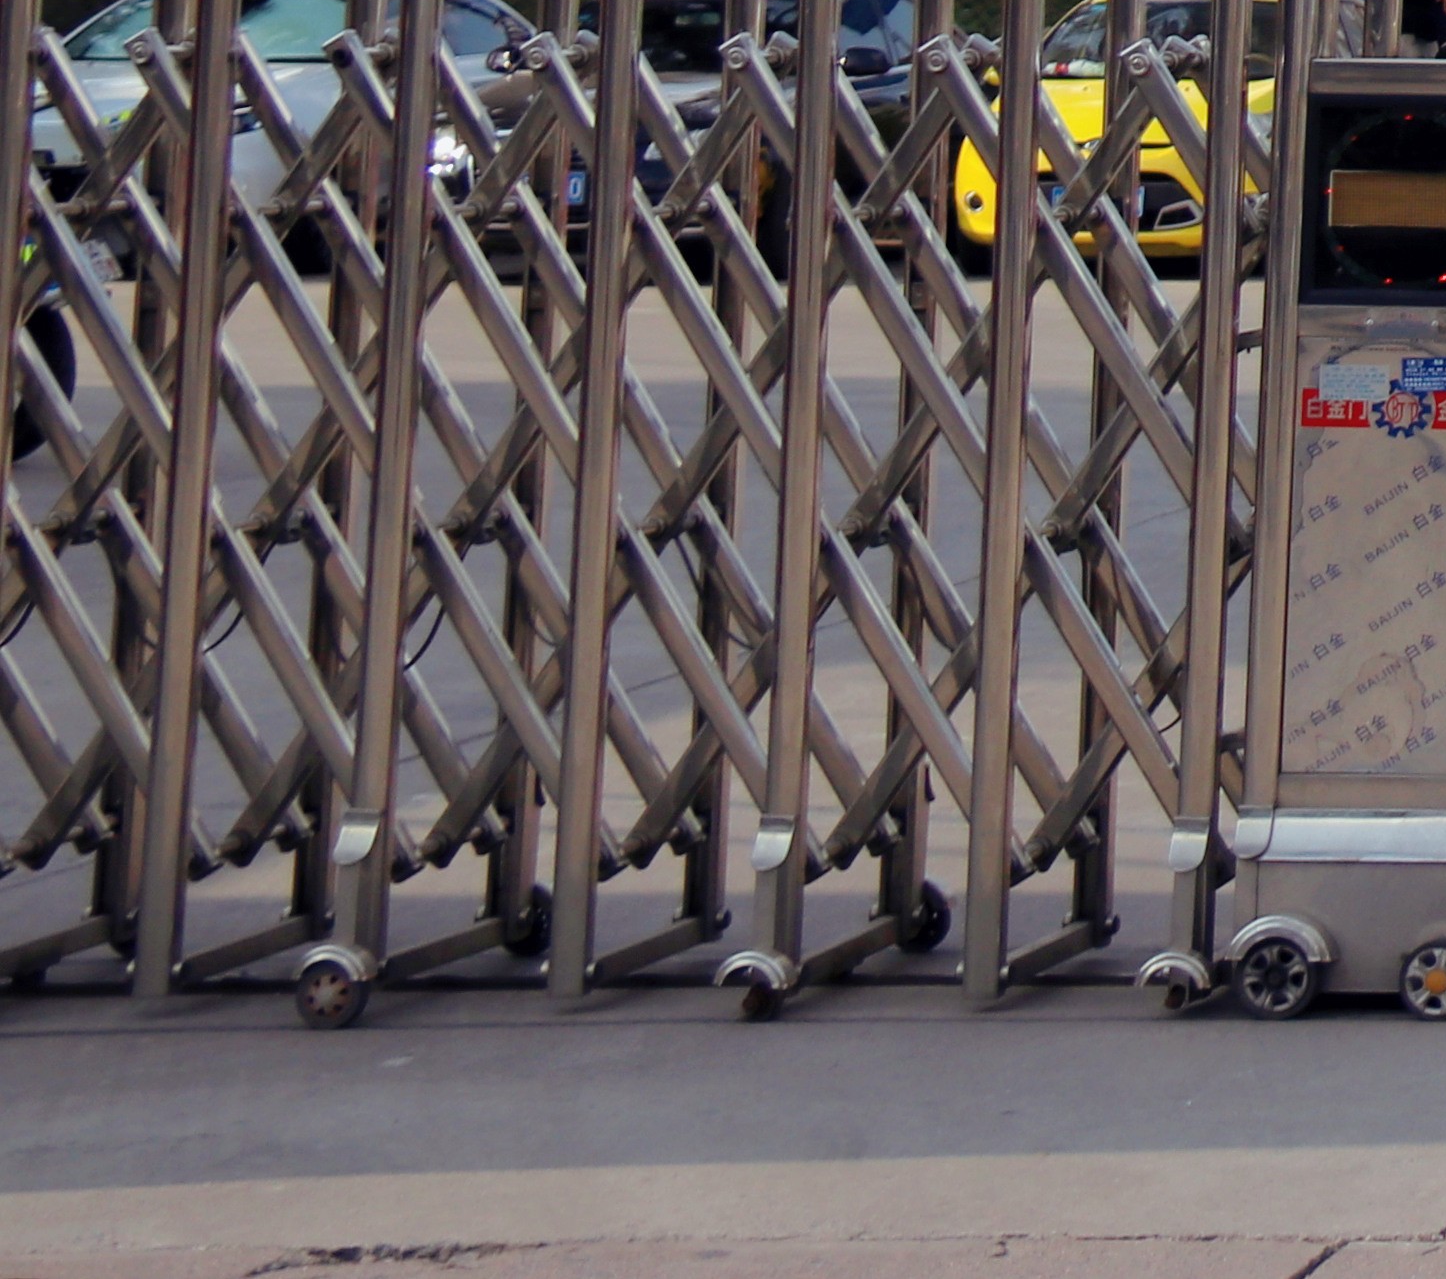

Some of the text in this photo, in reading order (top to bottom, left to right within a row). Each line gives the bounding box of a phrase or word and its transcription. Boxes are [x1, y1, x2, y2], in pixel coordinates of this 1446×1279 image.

[1363, 481, 1410, 516] BAIJIN
[1412, 454, 1446, 482] 白金
[1308, 494, 1343, 522] 白金
[1364, 503, 1446, 564] BAIJIN 白金
[1309, 563, 1343, 591] 白金
[1368, 598, 1414, 633] BAIJIN
[1312, 632, 1346, 661] 白金
[1356, 633, 1437, 695] BAIJIN 白金
[1309, 698, 1344, 727] 白金
[1354, 714, 1388, 742] 白金
